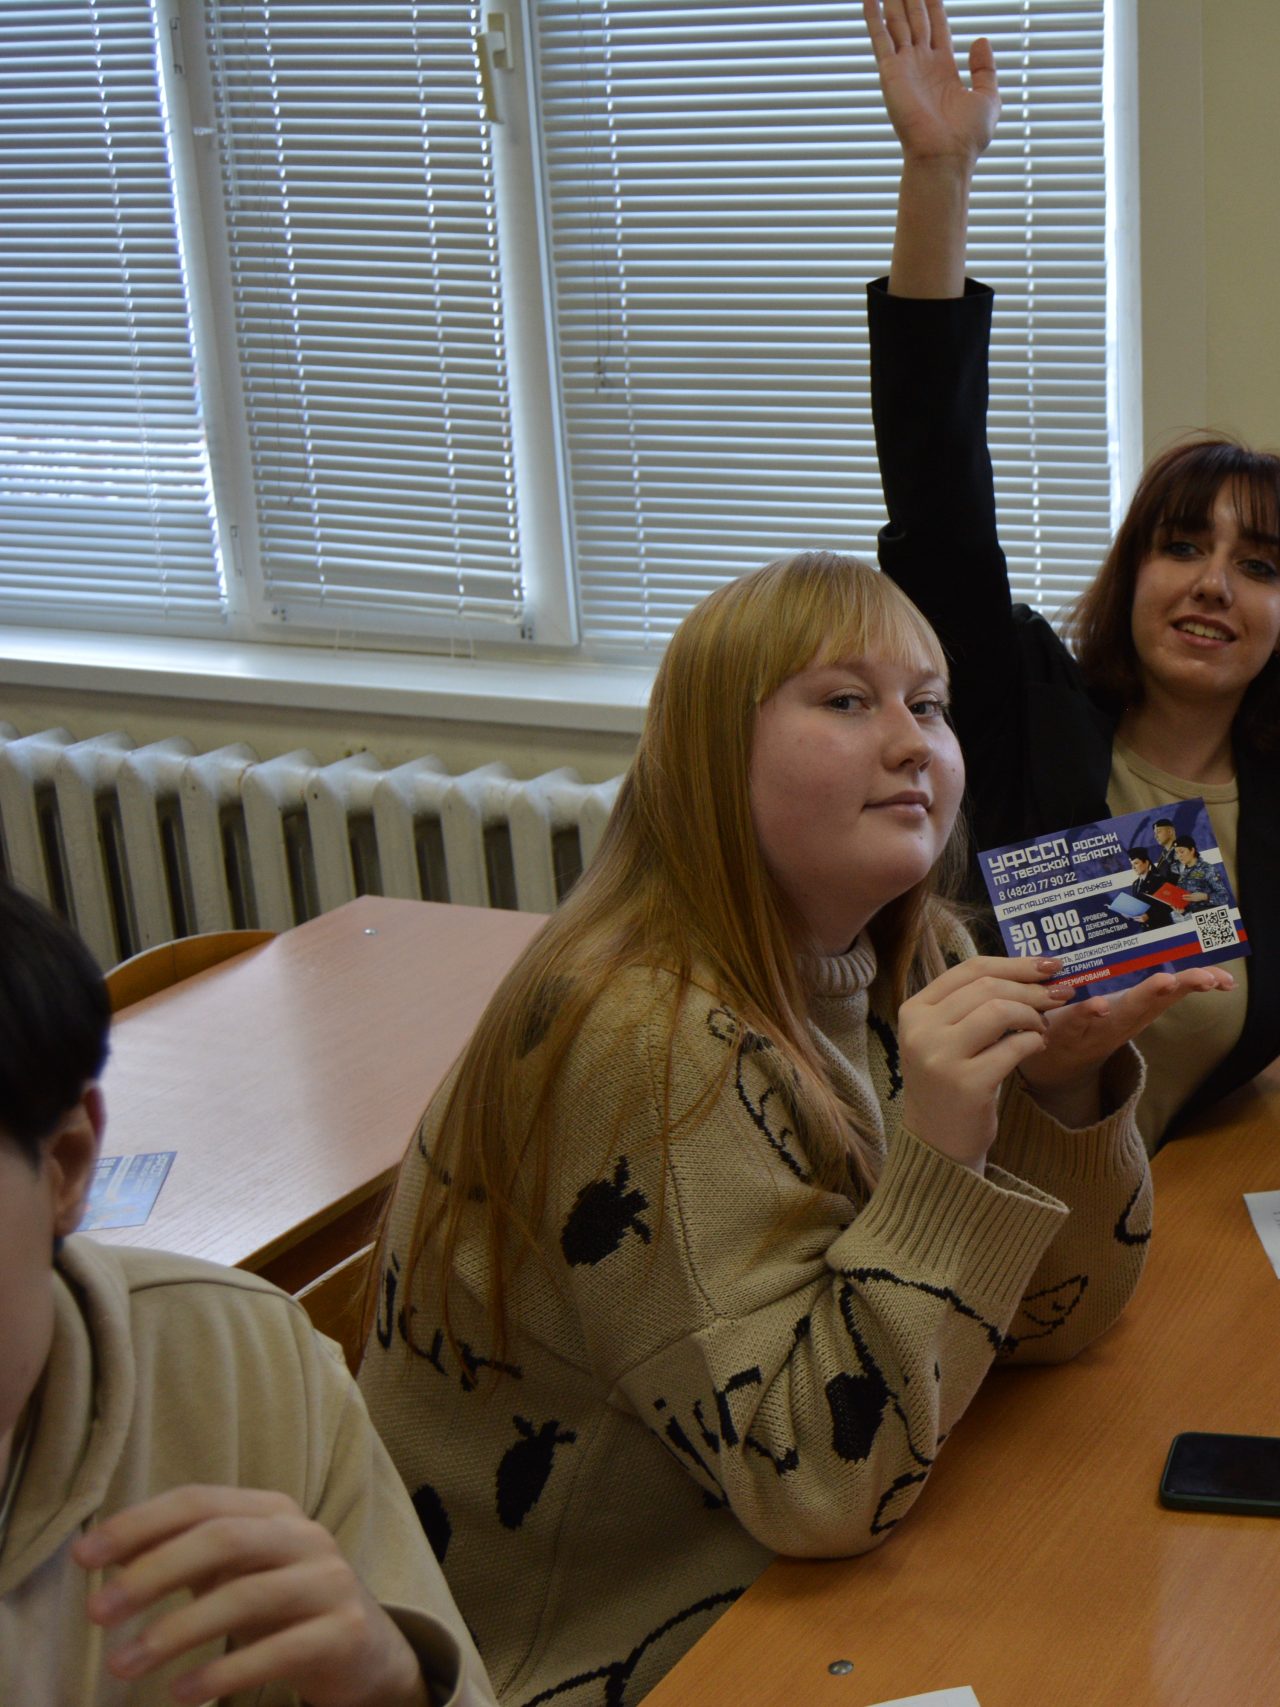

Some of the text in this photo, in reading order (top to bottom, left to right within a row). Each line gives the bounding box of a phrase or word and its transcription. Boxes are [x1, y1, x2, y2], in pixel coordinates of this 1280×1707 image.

[988, 832, 1118, 874] УФССП РОССИИ
[993, 844, 1122, 886] ПО ТВЕРСКОЙ ОБЛАСТИ
[999, 872, 1077, 901] 8 (4822) 77 90 22
[1003, 880, 1113, 915] ПРИГЛАШАЕМ НА СЛУЖБУ
[1009, 909, 1080, 942] 50 000
[1082, 912, 1108, 924] УРОВЕНЬ
[1085, 917, 1119, 931] ДЕНЕЖНОГО
[1088, 923, 1128, 940] ДОВОЛЬСТВИЯ
[1014, 926, 1085, 957] 70 000
[1074, 937, 1139, 961] ДОЛЖНОСТНОЙ РОСТ
[1071, 958, 1104, 973] ГАРАНТИИ
